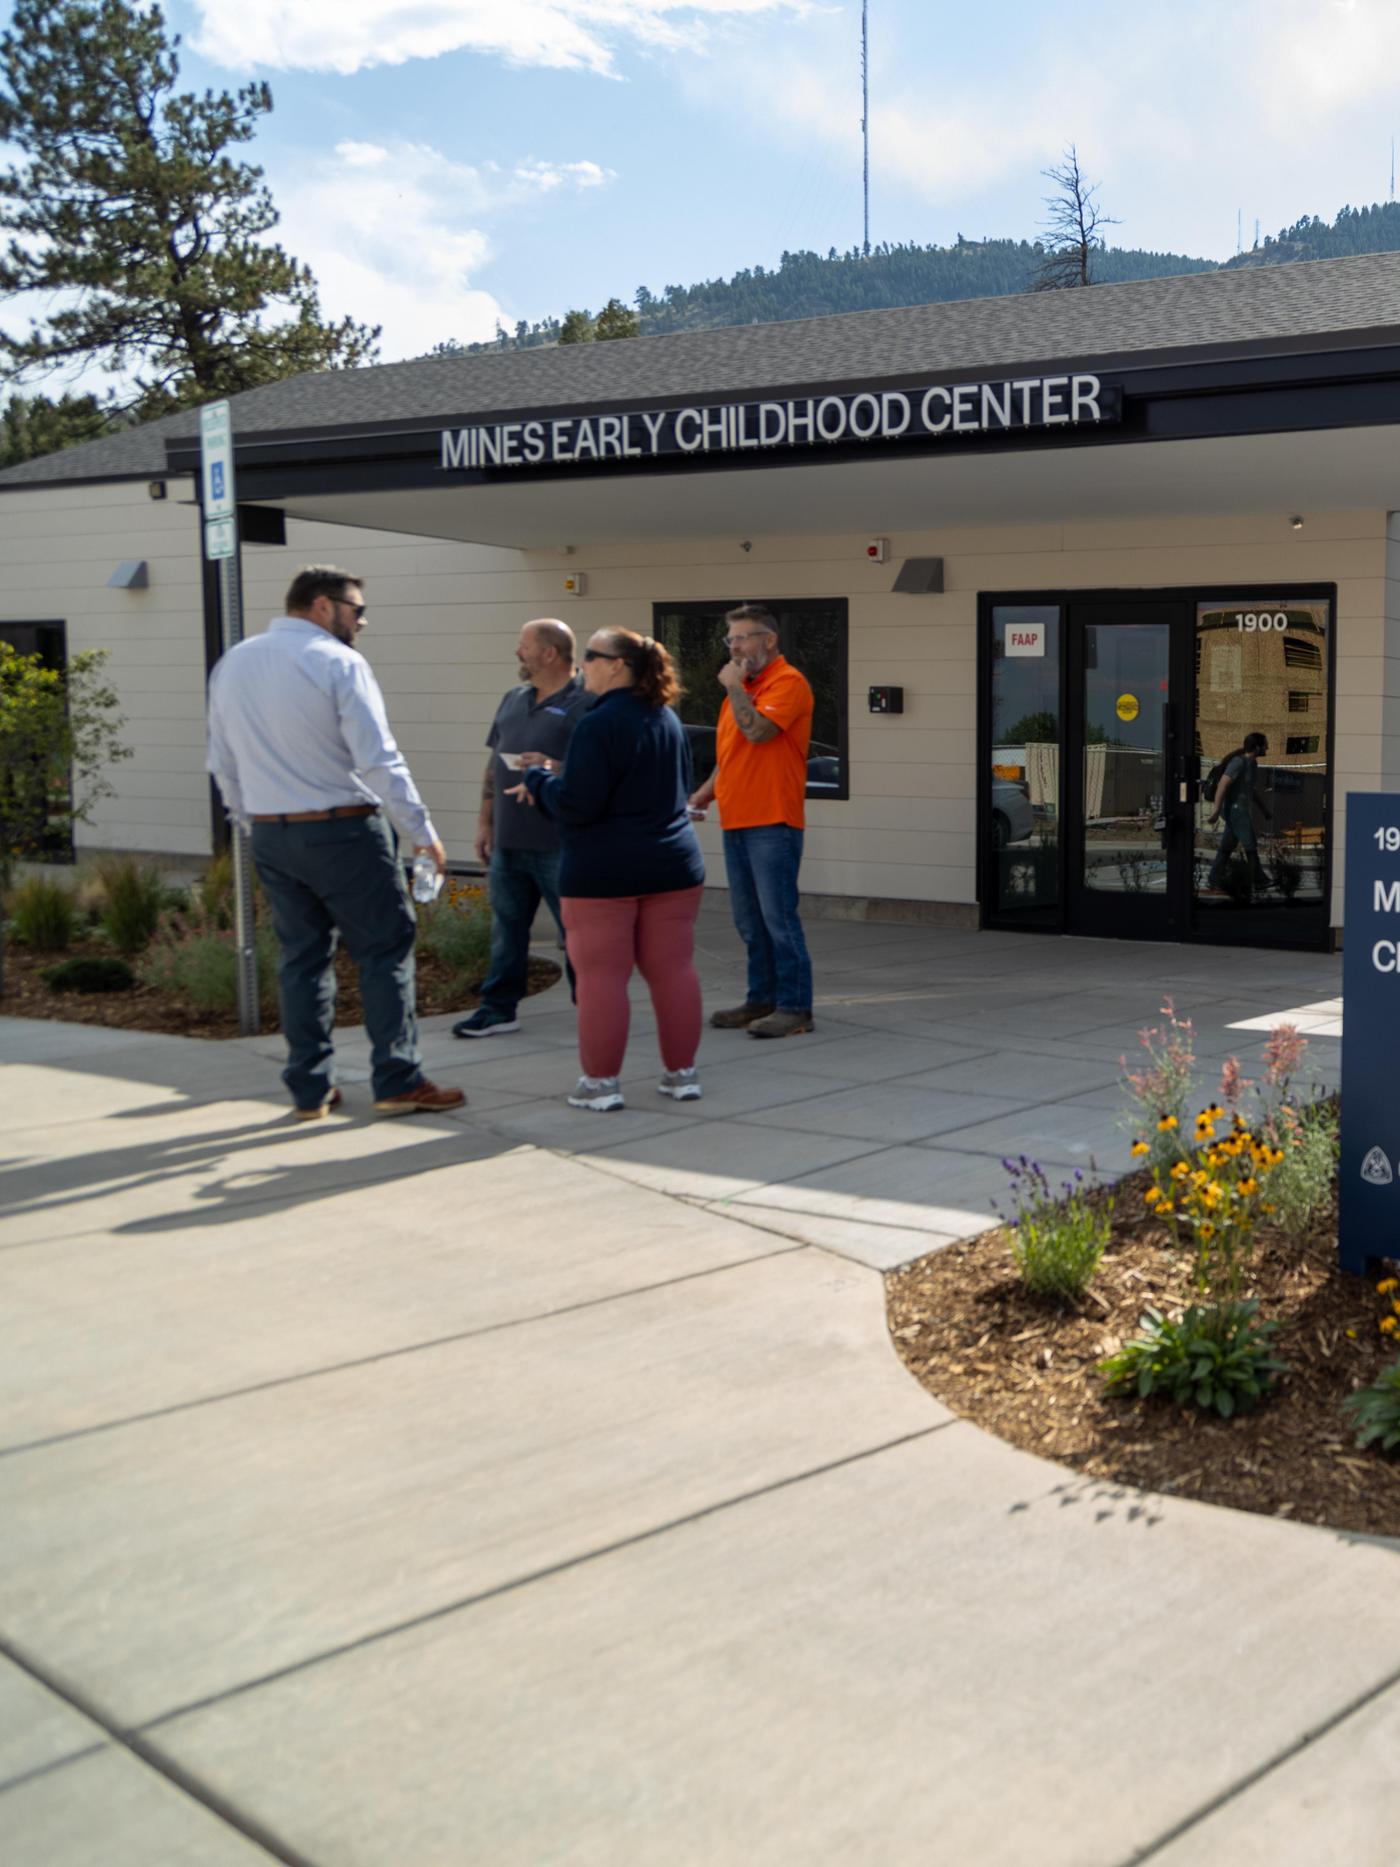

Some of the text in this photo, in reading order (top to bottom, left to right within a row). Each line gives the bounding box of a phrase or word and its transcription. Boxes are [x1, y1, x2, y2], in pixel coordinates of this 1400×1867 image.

[442, 374, 1101, 467] MINES EARLY CHILDHOOD CENTER
[1235, 612, 1288, 632] 1900
[1011, 633, 1038, 646] FAAP
